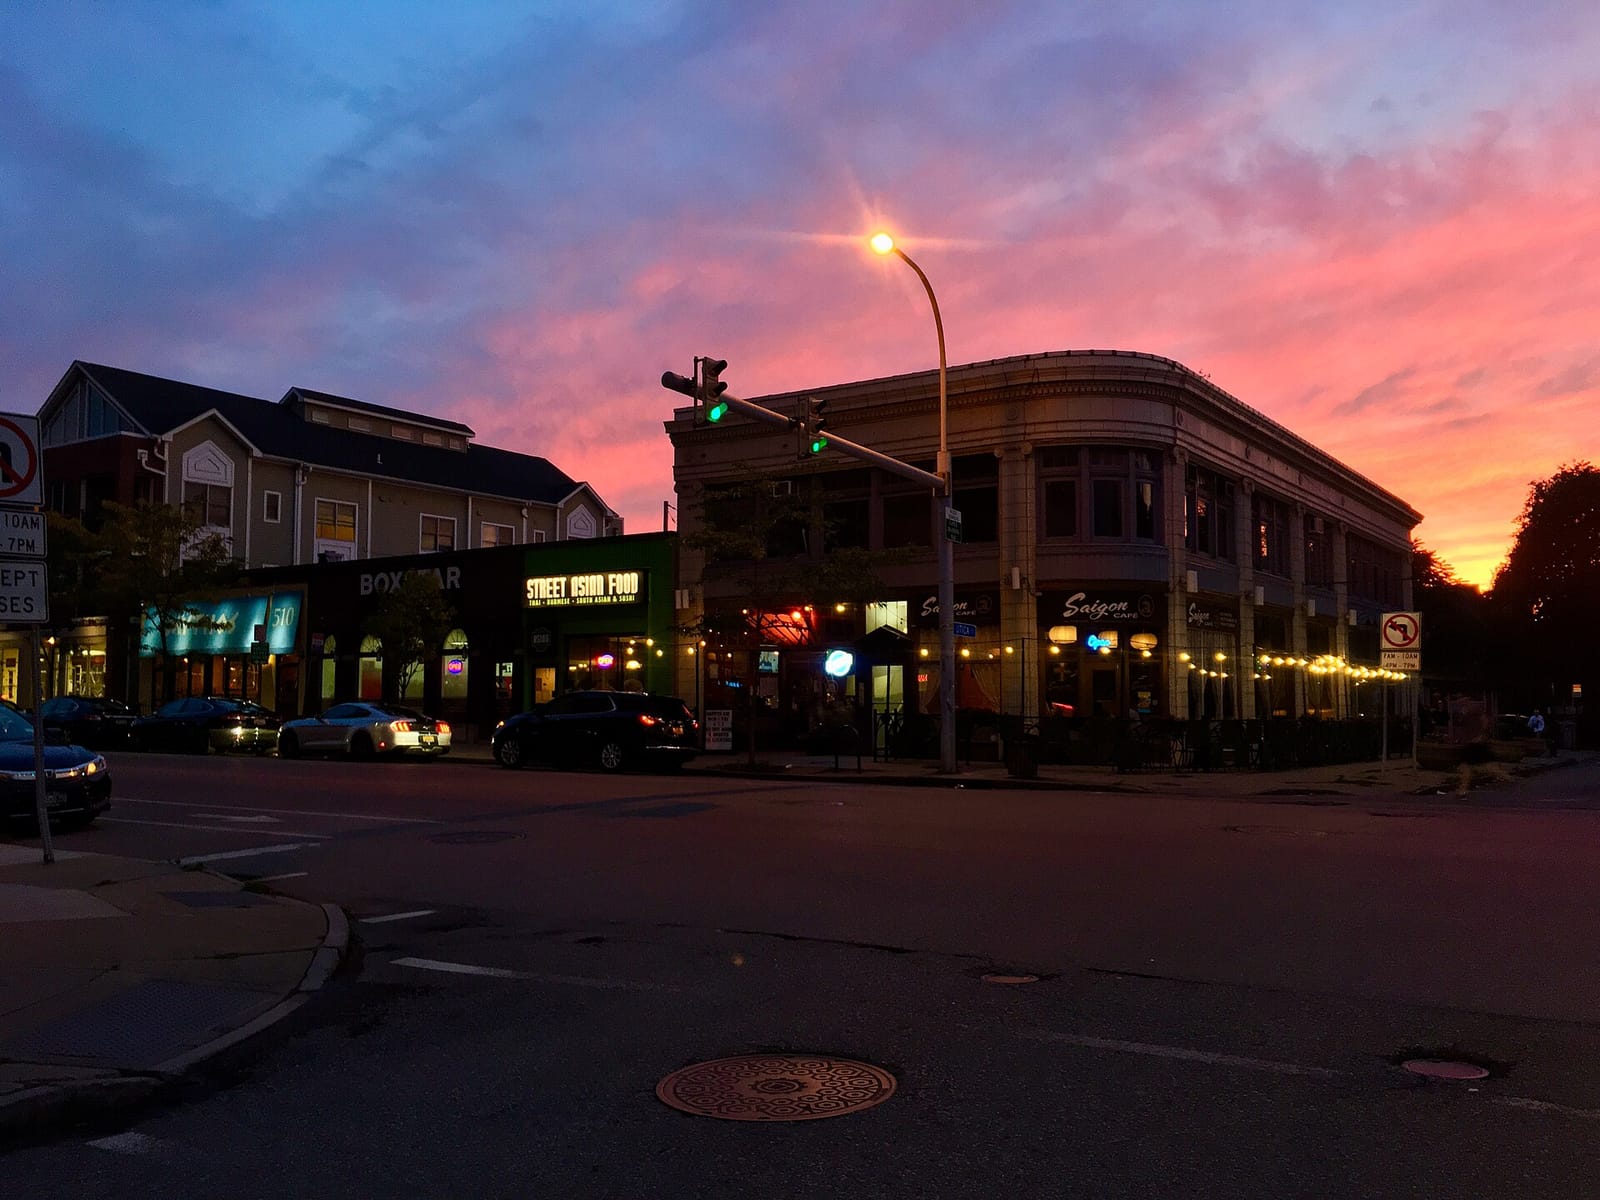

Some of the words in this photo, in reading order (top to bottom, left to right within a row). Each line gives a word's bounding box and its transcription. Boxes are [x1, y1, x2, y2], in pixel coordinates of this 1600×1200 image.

[5, 513, 40, 530] 10AM
[8, 537, 35, 552] 7PM
[526, 577, 567, 600] STREET
[570, 575, 604, 598] ASIAN
[608, 572, 639, 596] FOOD
[594, 596, 611, 604] ASIAN
[920, 596, 968, 616] Saon
[1062, 592, 1129, 620] Saigon
[272, 607, 295, 627] 510
